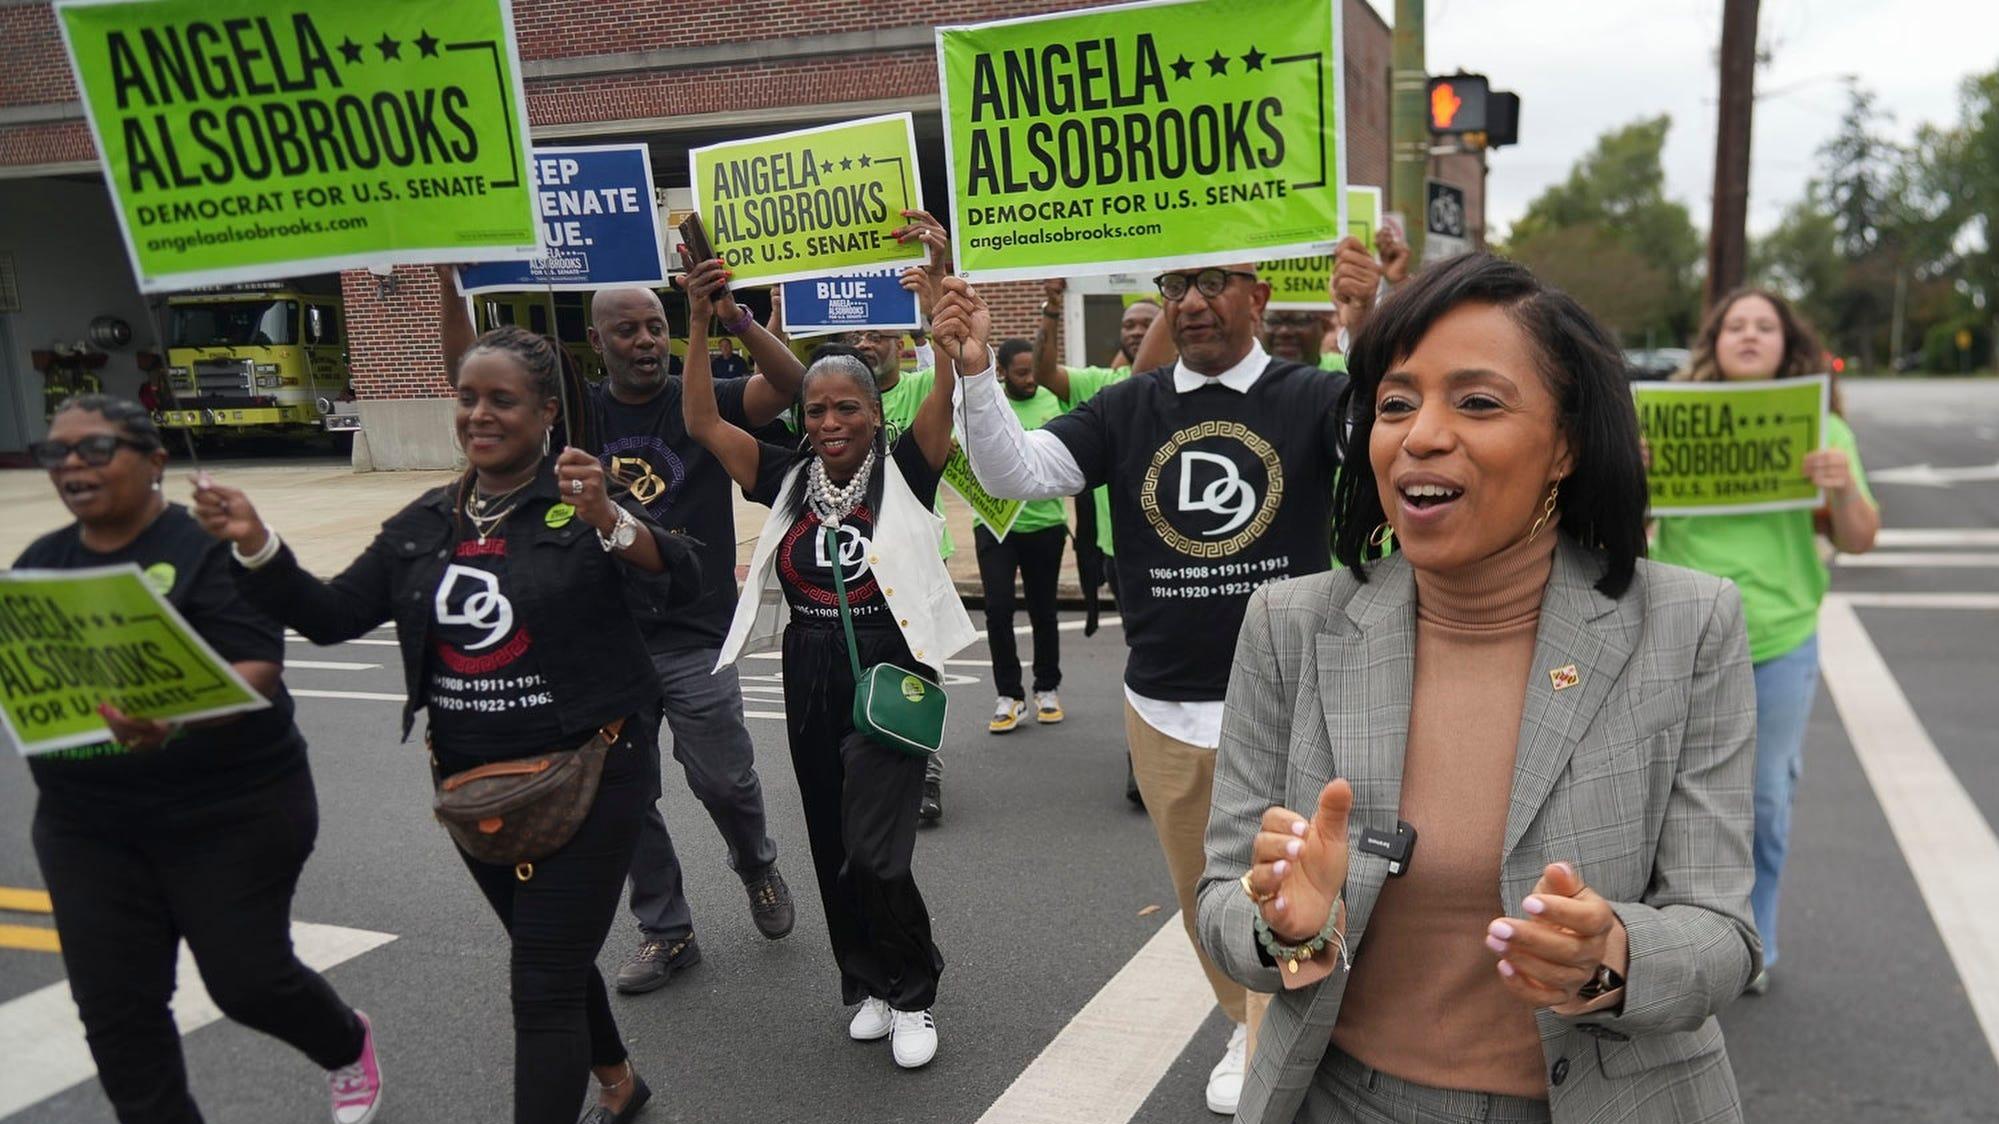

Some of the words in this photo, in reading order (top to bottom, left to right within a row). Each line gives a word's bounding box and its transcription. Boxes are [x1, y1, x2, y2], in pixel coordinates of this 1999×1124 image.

[107, 12, 342, 109] ANGELA
[970, 33, 1168, 123] ANGELA
[121, 86, 478, 193] ALSOBROOKS
[967, 97, 1285, 197] ALSOBROOKS
[714, 149, 820, 201] ANGELA
[138, 191, 284, 227] DEMOCRAT
[294, 188, 346, 209] FOR
[352, 182, 400, 203] U.S.
[408, 175, 486, 199] SENATE
[540, 187, 640, 217] ENATE
[714, 181, 887, 245] ALSOBROOKS
[968, 199, 1093, 226] DEMOCRAT
[1102, 195, 1147, 214] FOR
[1154, 190, 1198, 210] U.S.
[1206, 180, 1287, 206] SENATE
[147, 213, 367, 253] angelaalsobrooks.com
[544, 221, 593, 246] UE.
[717, 246, 755, 267] FOR
[761, 241, 800, 262] U.S.
[806, 230, 881, 256] SENATE
[970, 222, 1162, 251] angelaalsobrooks.com
[817, 280, 873, 299] BLUE.
[1284, 277, 1331, 292] SENA
[1650, 437, 1792, 477] LSOBROOKS
[1178, 451, 1256, 535] D9
[1150, 568, 1173, 579] 1906
[1179, 566, 1209, 578] 1908
[1218, 563, 1250, 576] 1911
[1151, 586, 1172, 598] 1914
[1179, 586, 1209, 598] 1920
[1219, 582, 1251, 595] 1922
[435, 563, 513, 650] D9
[814, 608, 839, 617] 1908
[473, 679, 505, 691] 1911
[516, 674, 547, 688] 191
[473, 699, 506, 712] 1922
